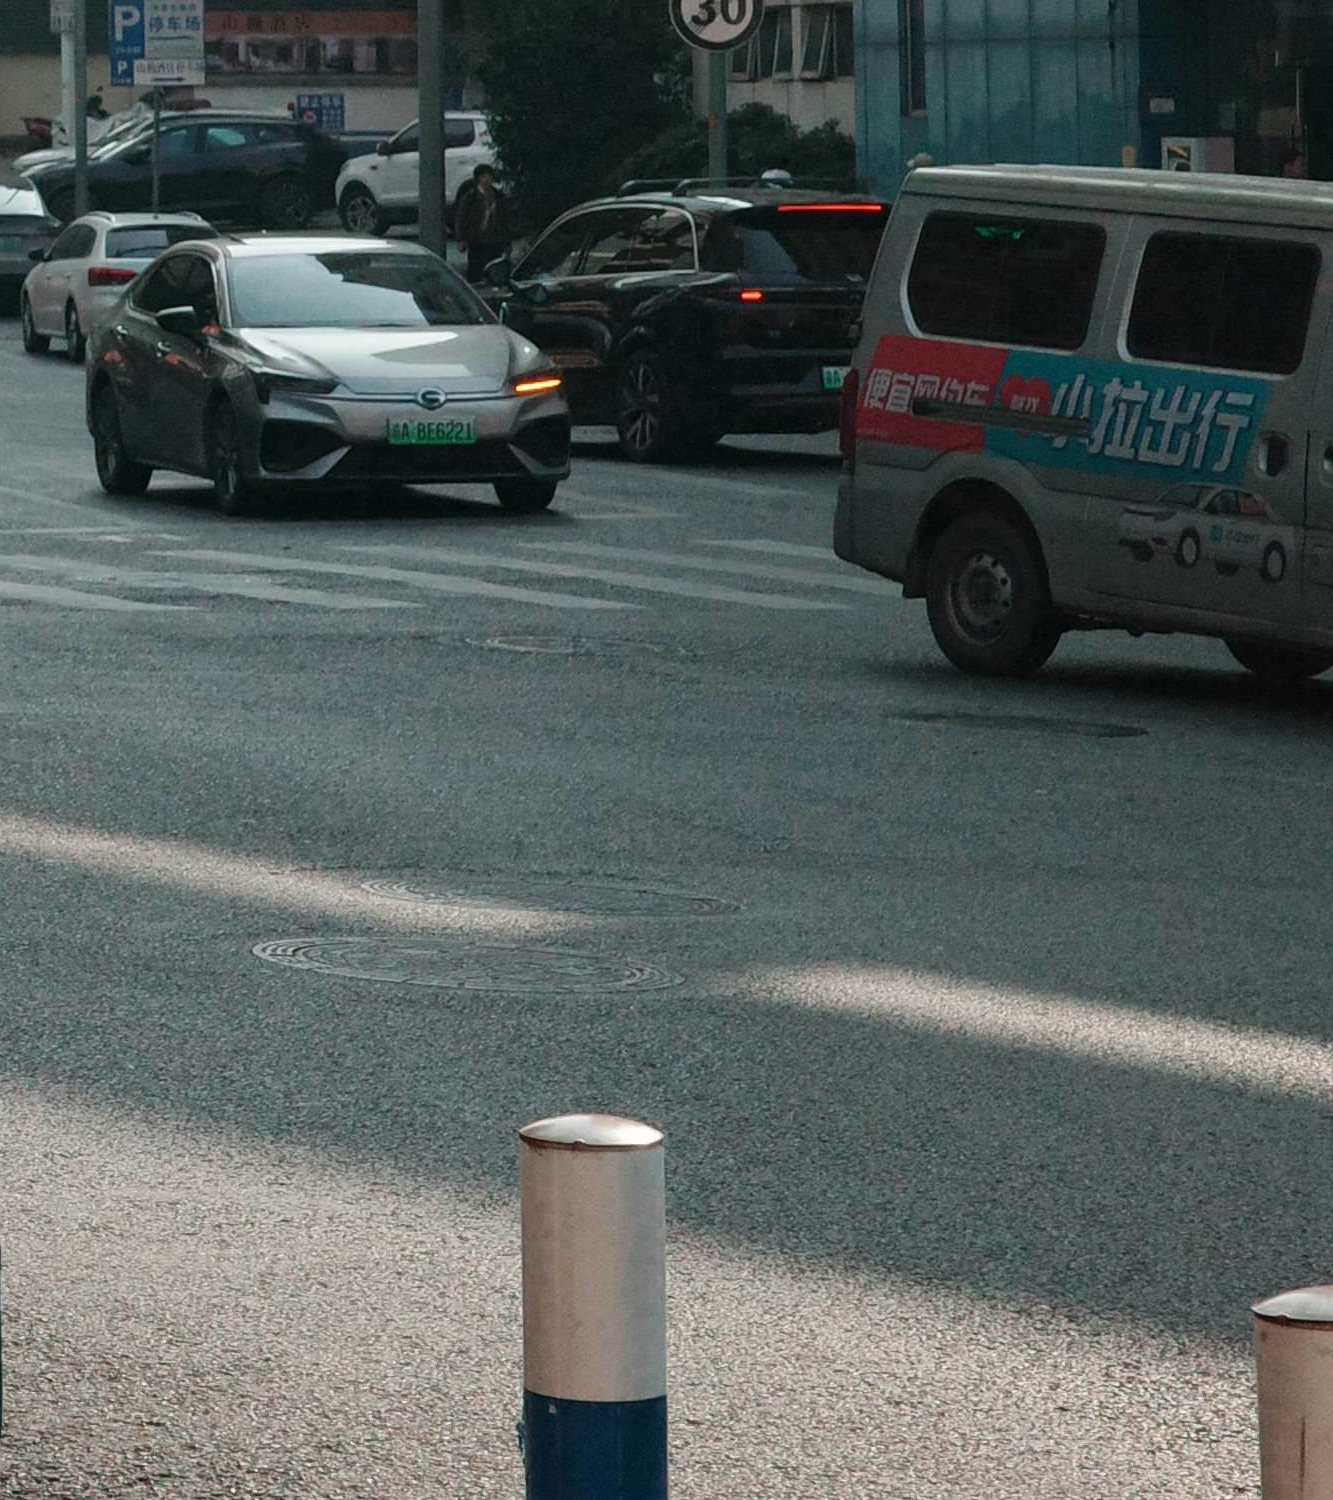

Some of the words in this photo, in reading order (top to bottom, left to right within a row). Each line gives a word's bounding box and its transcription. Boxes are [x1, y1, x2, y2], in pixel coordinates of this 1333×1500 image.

[114, 5, 141, 41] P
[1047, 373, 1255, 474] 小拉出行
